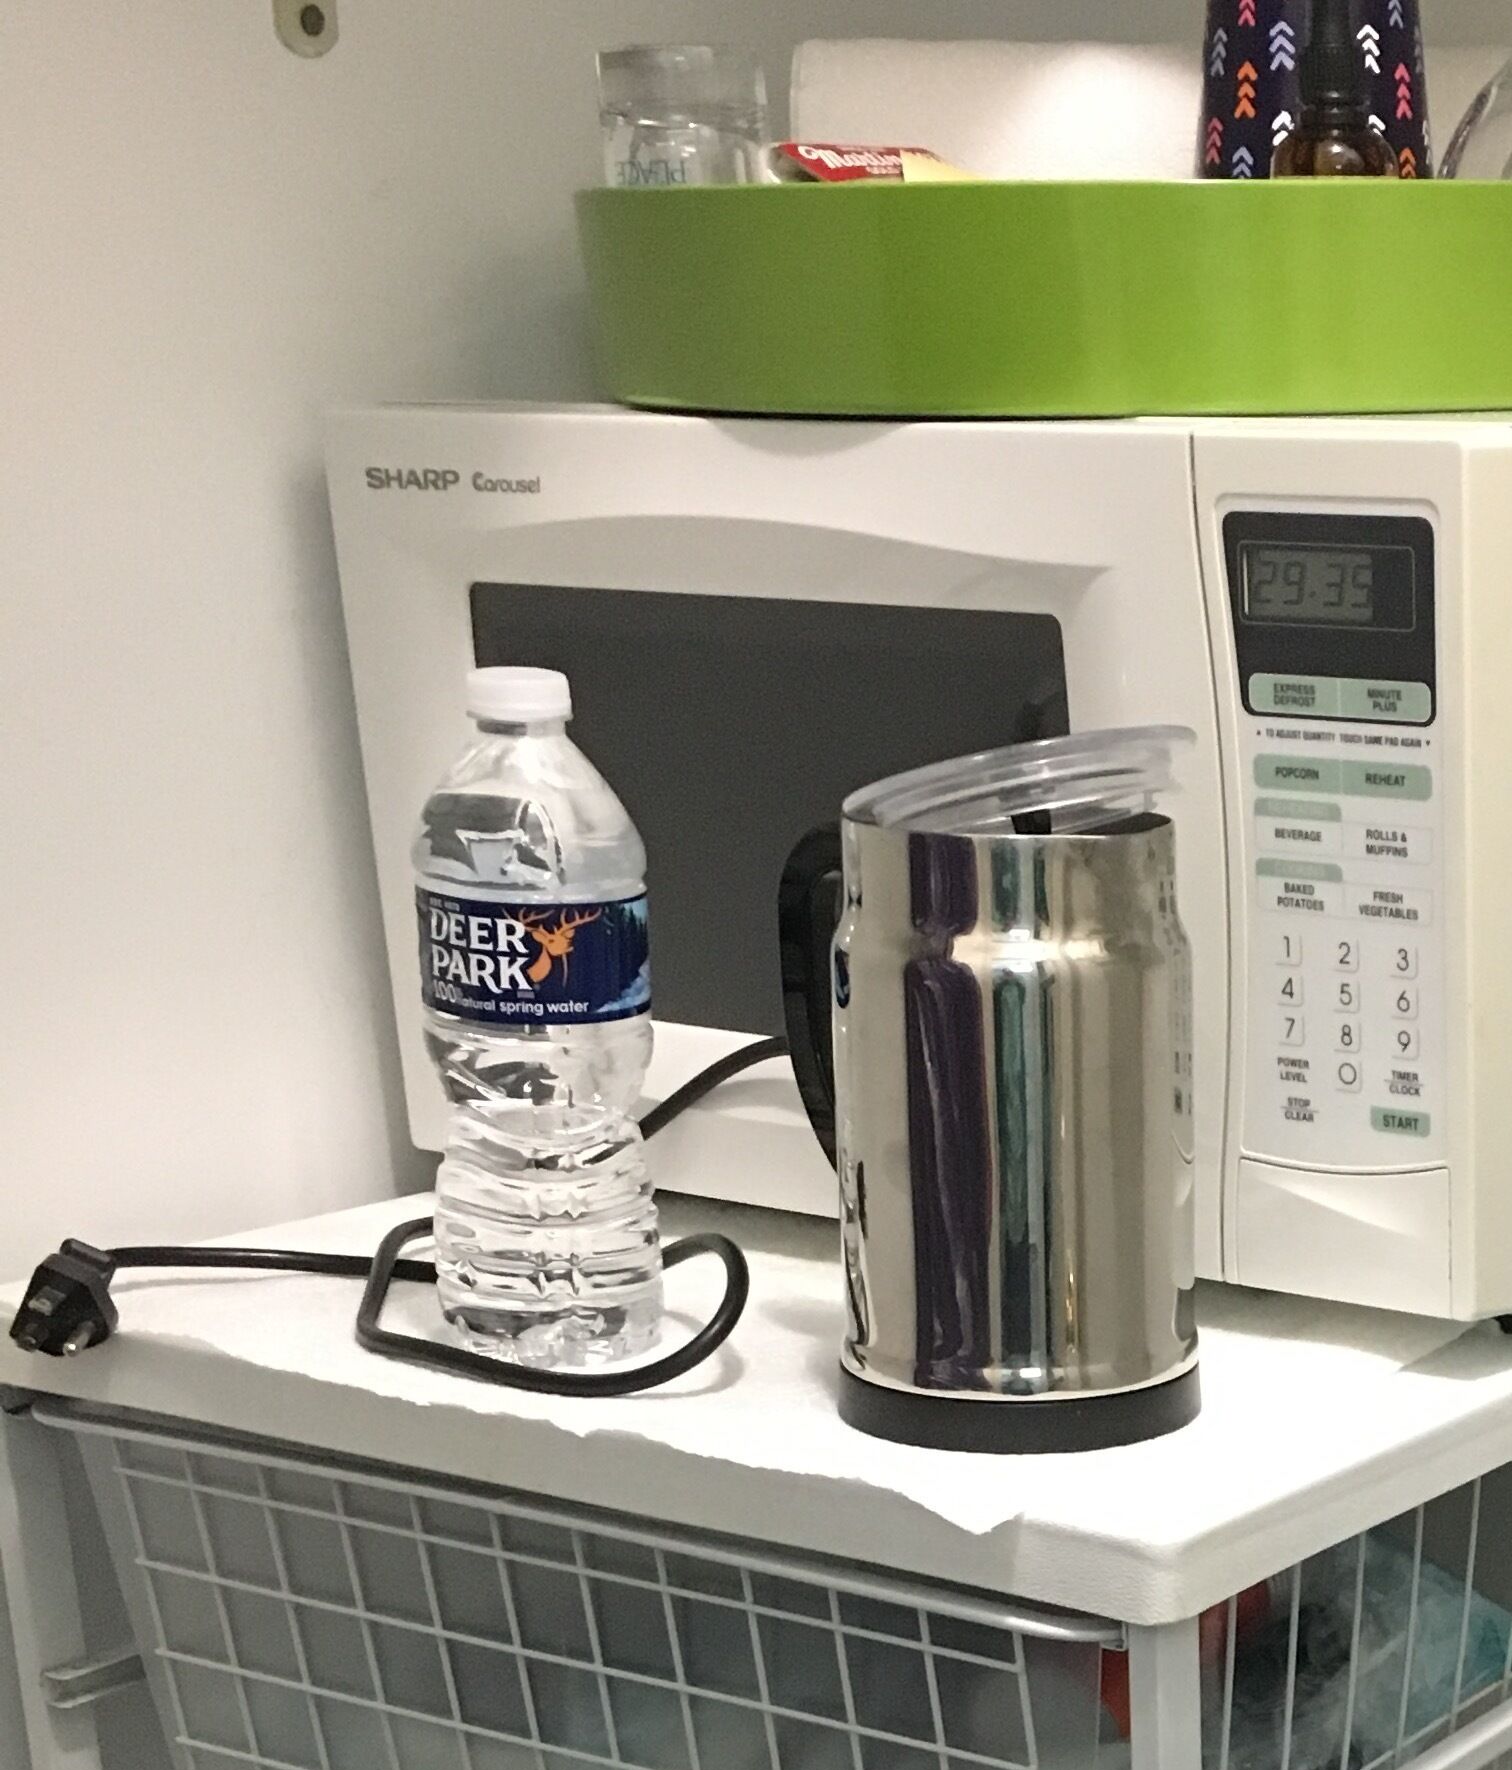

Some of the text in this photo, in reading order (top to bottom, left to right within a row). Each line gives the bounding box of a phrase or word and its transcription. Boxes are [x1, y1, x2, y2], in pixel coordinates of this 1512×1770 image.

[365, 467, 541, 493] SHARP Carousel
[1273, 683, 1316, 696] EXPRESS
[1367, 688, 1402, 701] MINUTE
[1273, 694, 1316, 708] DEFROST
[1373, 701, 1397, 713] PLUS
[1275, 766, 1319, 780] POPCORN
[1365, 773, 1405, 787] REHEAT
[1274, 827, 1321, 842] BEVERAGE
[1365, 829, 1407, 843] ROLLS &
[1365, 844, 1408, 858] MUFFINS
[1284, 882, 1314, 896] BAKED
[1277, 896, 1324, 912] POTATOES
[1373, 891, 1403, 904] FRESH
[1359, 904, 1418, 921] VEGETABLES
[429, 907, 530, 954] DEER
[1283, 936, 1291, 958] 1
[1338, 942, 1351, 965] 2
[1396, 948, 1410, 972] 3
[431, 943, 533, 994] PARK
[1281, 977, 1295, 999] 4
[1339, 983, 1352, 1006] 5
[499, 1001, 544, 1016] spring
[546, 1000, 589, 1013] water
[1396, 990, 1411, 1012] 6
[1284, 1017, 1296, 1039] 7
[1340, 1024, 1353, 1046] 8
[1397, 1030, 1411, 1052] 9
[1277, 1057, 1309, 1070] POWER
[1280, 1071, 1307, 1083] LEVEL
[1391, 1070, 1419, 1083] TIMER
[1389, 1084, 1421, 1097] CLOCK
[1287, 1097, 1311, 1108] STOP
[1284, 1109, 1314, 1122] CLEAR
[1383, 1114, 1418, 1131] START
